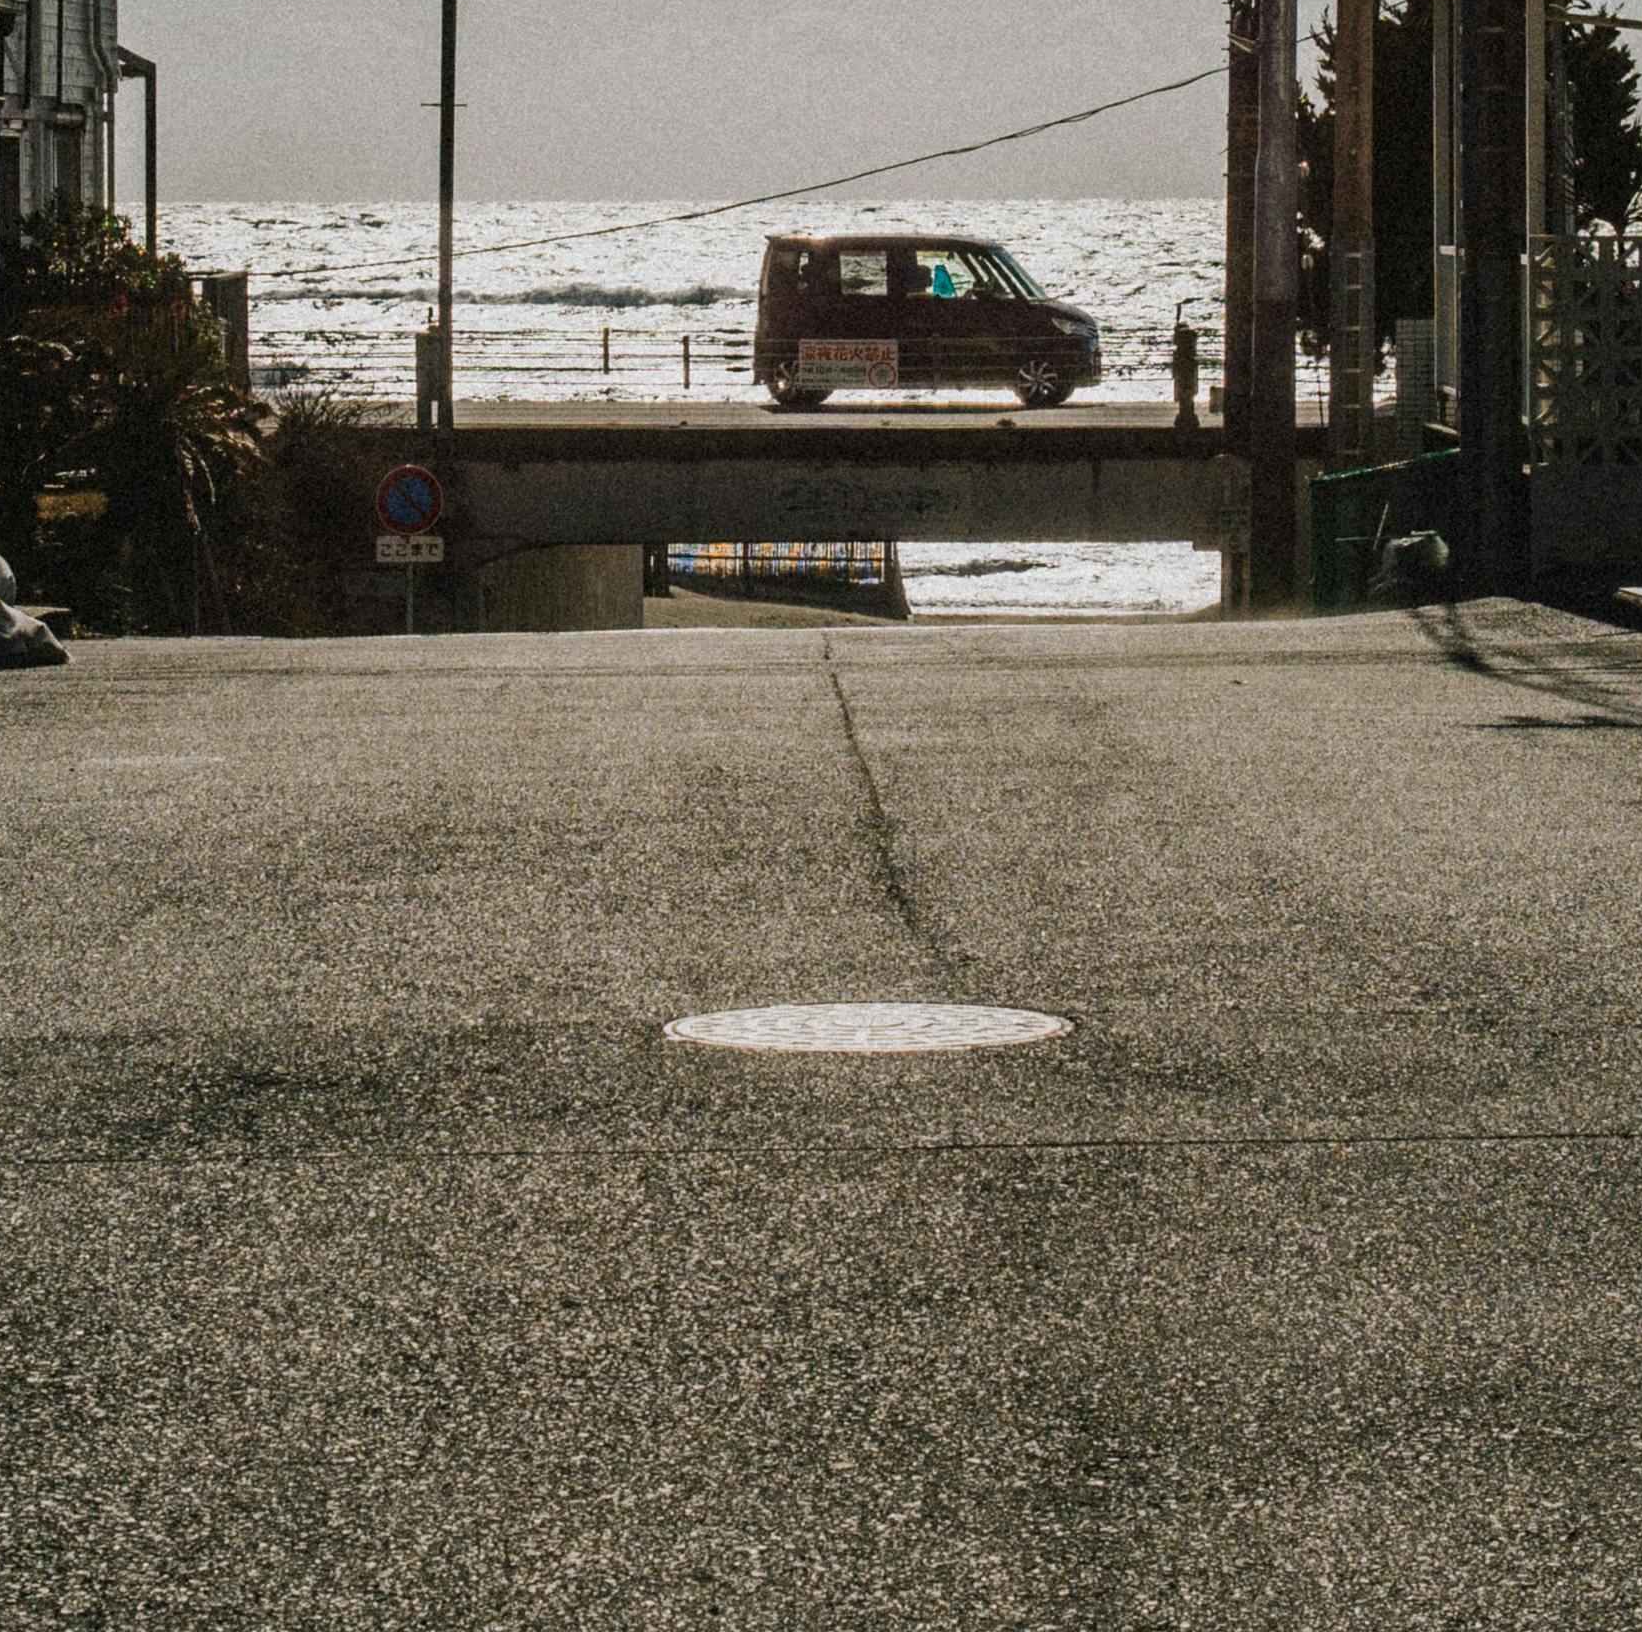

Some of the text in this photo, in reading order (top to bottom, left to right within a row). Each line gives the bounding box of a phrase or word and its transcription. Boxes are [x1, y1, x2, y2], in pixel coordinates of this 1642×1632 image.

[802, 344, 894, 361] 深夜花火禁止
[380, 542, 439, 557] ここまで
